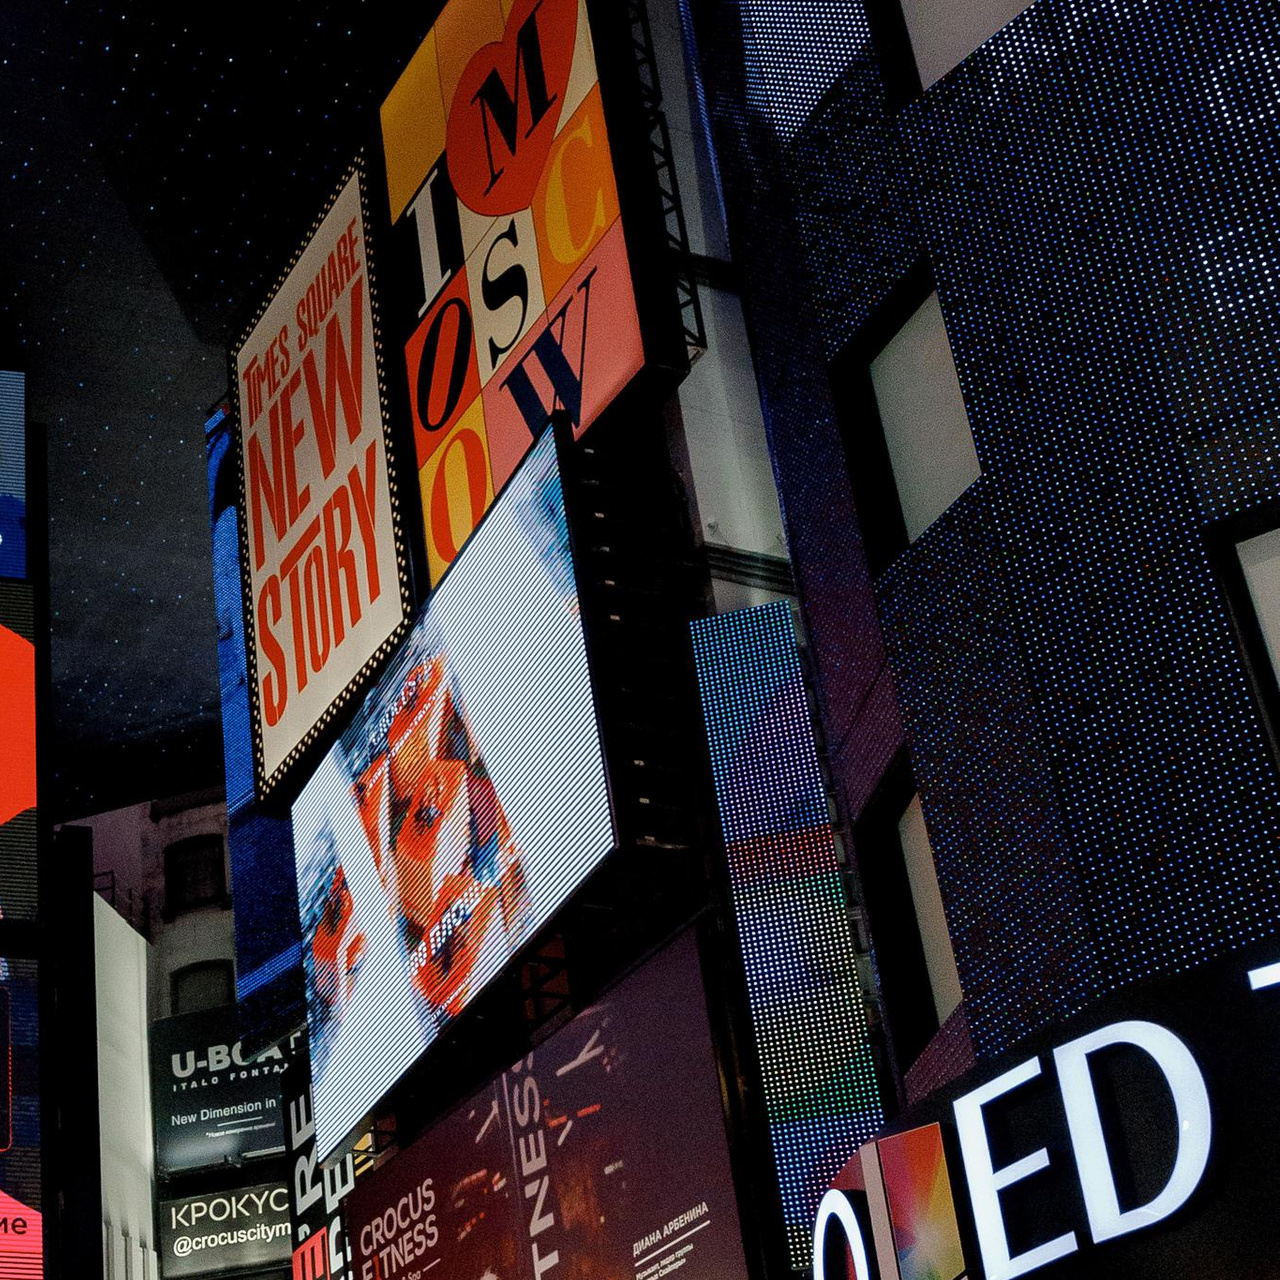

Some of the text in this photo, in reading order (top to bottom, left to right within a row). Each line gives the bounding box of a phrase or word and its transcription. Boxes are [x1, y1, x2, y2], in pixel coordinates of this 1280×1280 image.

[242, 216, 363, 430] TIMES SQUARE
[246, 275, 366, 576] NEW
[257, 460, 381, 728] STORY
[171, 1098, 276, 1126] New Dimension in
[173, 1077, 218, 1092] ITALO
[171, 1188, 289, 1229] КРОКУС
[360, 1178, 435, 1256] CROCUS
[633, 1201, 709, 1258] ДИАНА АРБЕНИНА
[173, 1222, 291, 1257] @crocuscitym
